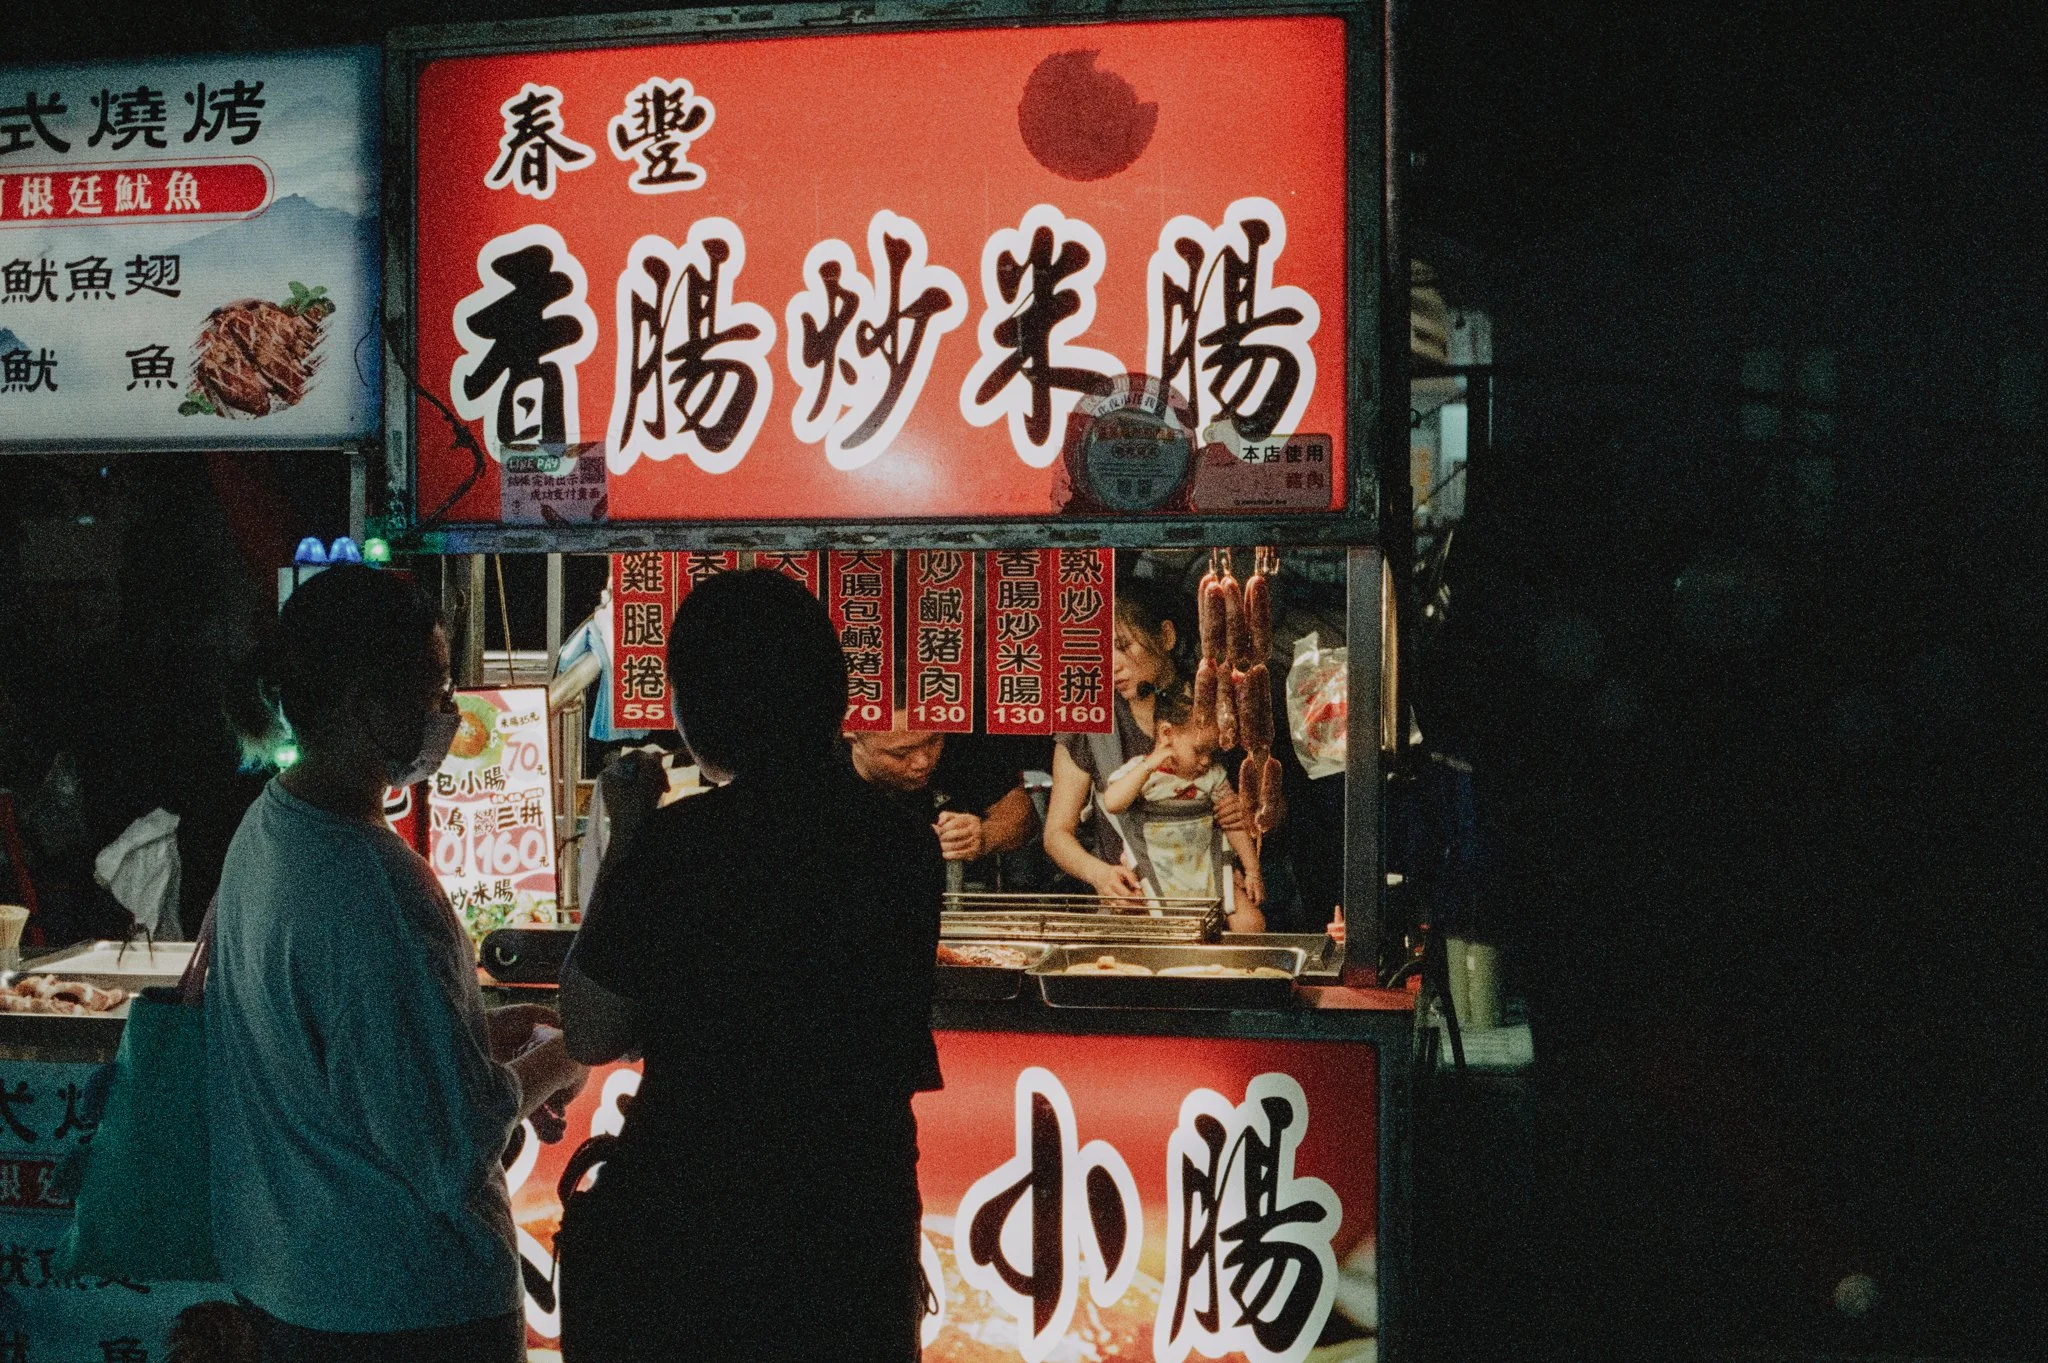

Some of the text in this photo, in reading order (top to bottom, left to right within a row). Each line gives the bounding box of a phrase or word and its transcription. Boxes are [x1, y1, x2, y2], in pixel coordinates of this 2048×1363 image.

[0, 81, 266, 153] 式燒烤
[490, 84, 708, 192] 春豐
[1, 254, 181, 304] 魷魚翅
[462, 216, 1308, 455] 香腸炒米腸
[1242, 444, 1323, 464] 本店使用
[622, 552, 664, 700] 雞腿捲
[918, 551, 963, 703] 炒鹹豬肉
[996, 551, 1042, 705] 香腸炒米腸
[1059, 550, 1103, 704] 熱炒三拼
[623, 703, 665, 720] 55
[914, 706, 965, 722] 130
[993, 708, 1044, 724] 130
[1055, 706, 1105, 723] 160
[427, 767, 506, 797] 包小腸
